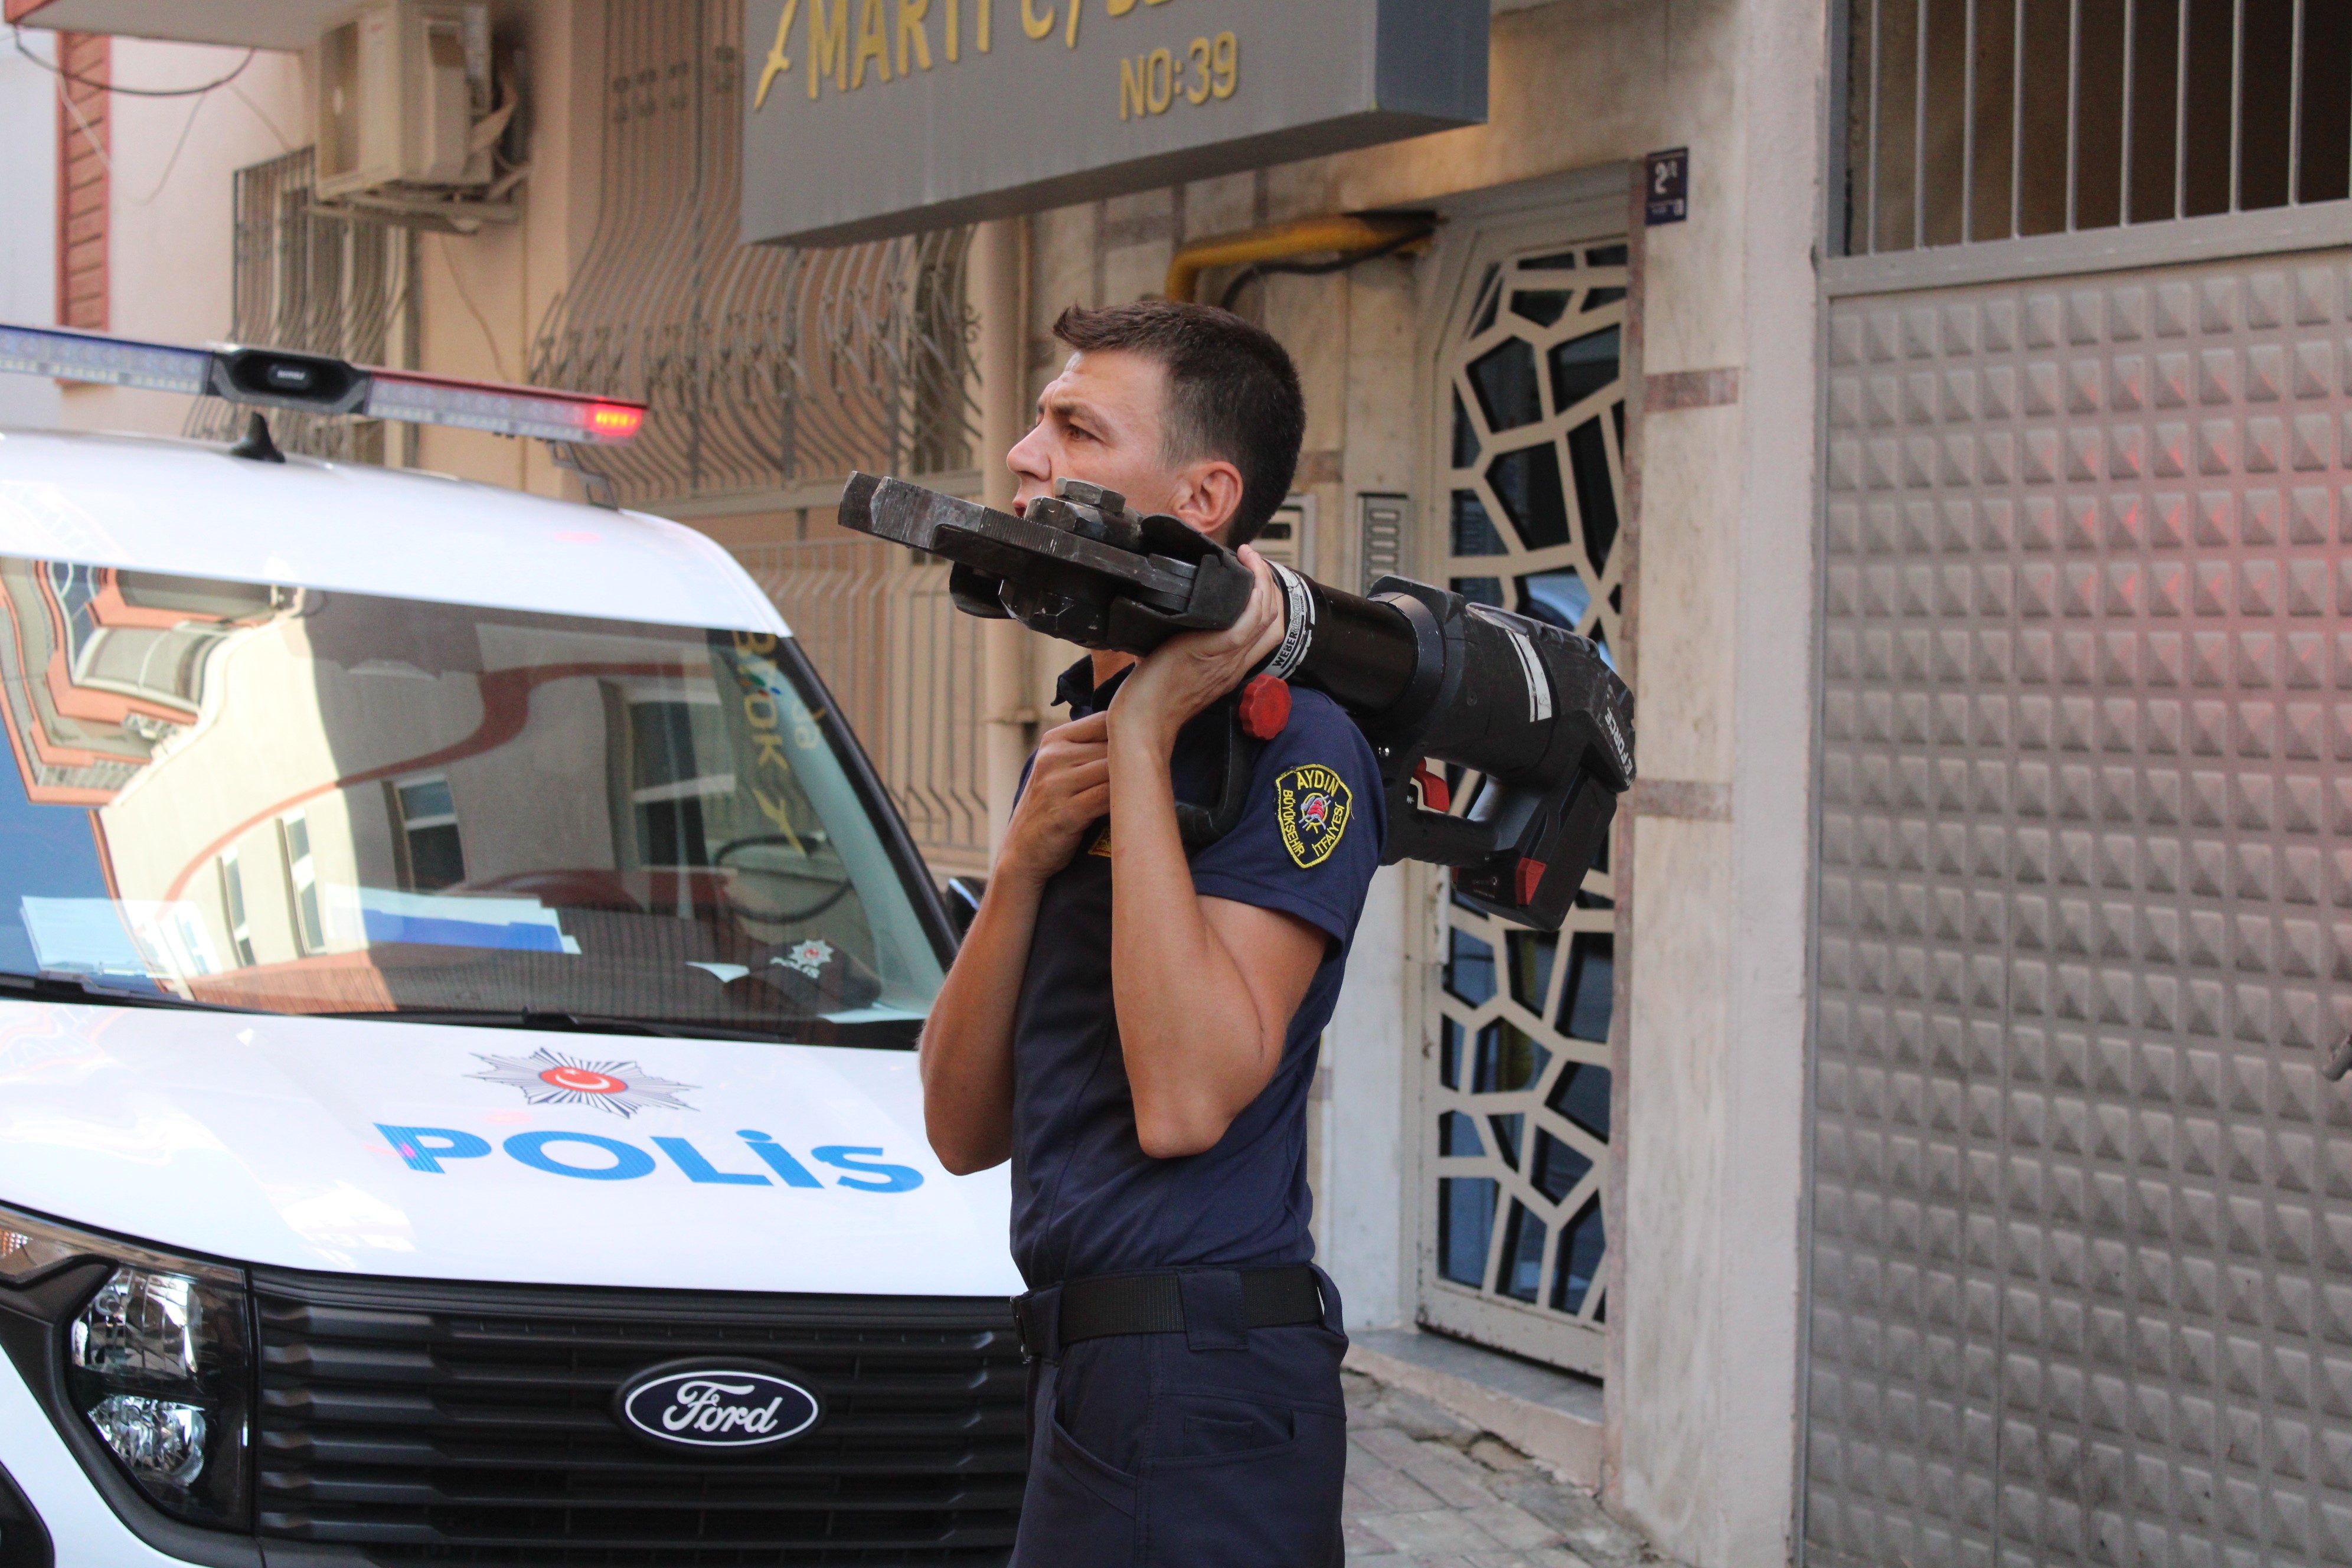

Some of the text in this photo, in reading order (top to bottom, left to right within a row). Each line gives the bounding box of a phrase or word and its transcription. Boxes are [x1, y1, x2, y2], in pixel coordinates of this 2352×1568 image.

[1120, 31, 1237, 120] NO:39
[1296, 770, 1339, 797] AYDIN
[1283, 789, 1305, 857] BÜYÜKŞEHİR
[1312, 802, 1345, 857] İTFAİYESİ
[662, 1380, 783, 1433] Ford
